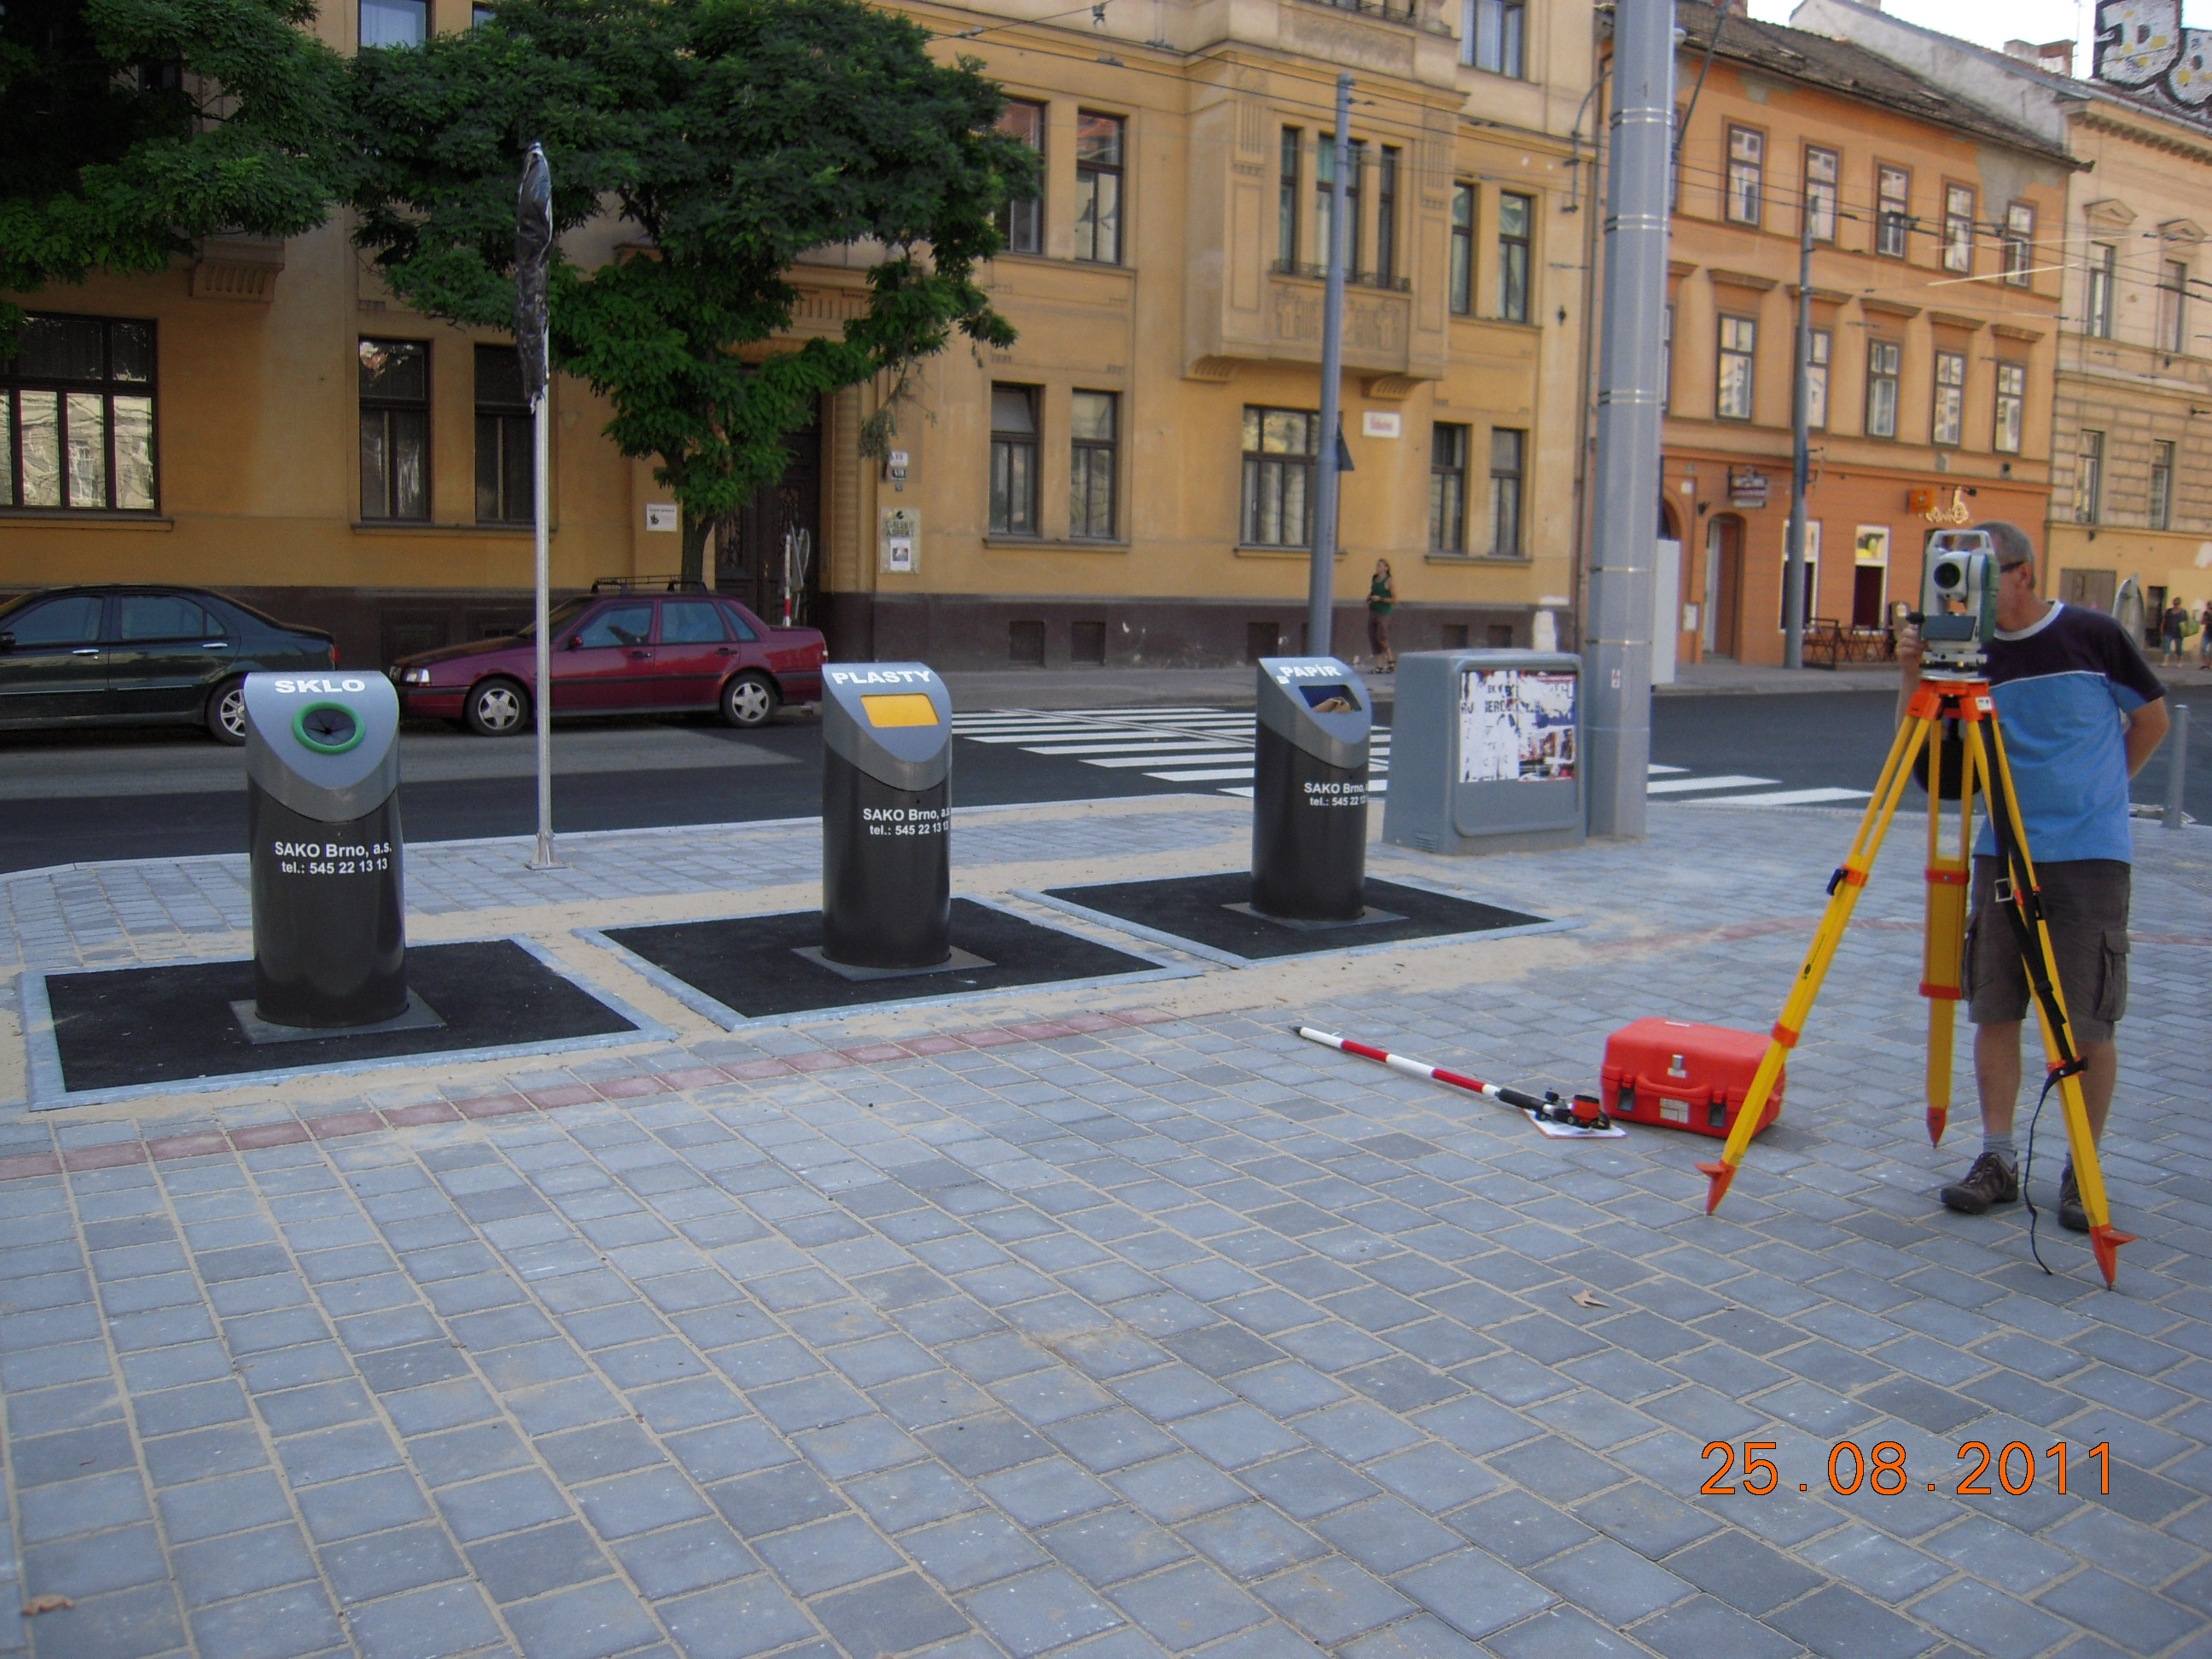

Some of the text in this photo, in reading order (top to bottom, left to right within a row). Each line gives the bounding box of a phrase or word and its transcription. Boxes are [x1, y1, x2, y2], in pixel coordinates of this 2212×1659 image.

[1279, 664, 1342, 677] PAPÍR
[831, 671, 929, 684] PLASTY
[275, 679, 365, 693] SKLO
[1304, 783, 1341, 794] SAKO
[1309, 796, 1329, 806] tel.:
[1331, 796, 1348, 806] 545
[1350, 795, 1359, 806] 22
[863, 808, 905, 821] SAKO
[908, 809, 939, 821] Brno,
[870, 819, 949, 835] tel.: 545 22 13 13
[275, 841, 392, 858] SAKO Brno, a.s.
[282, 857, 387, 874] tel.: 545 22 13 13
